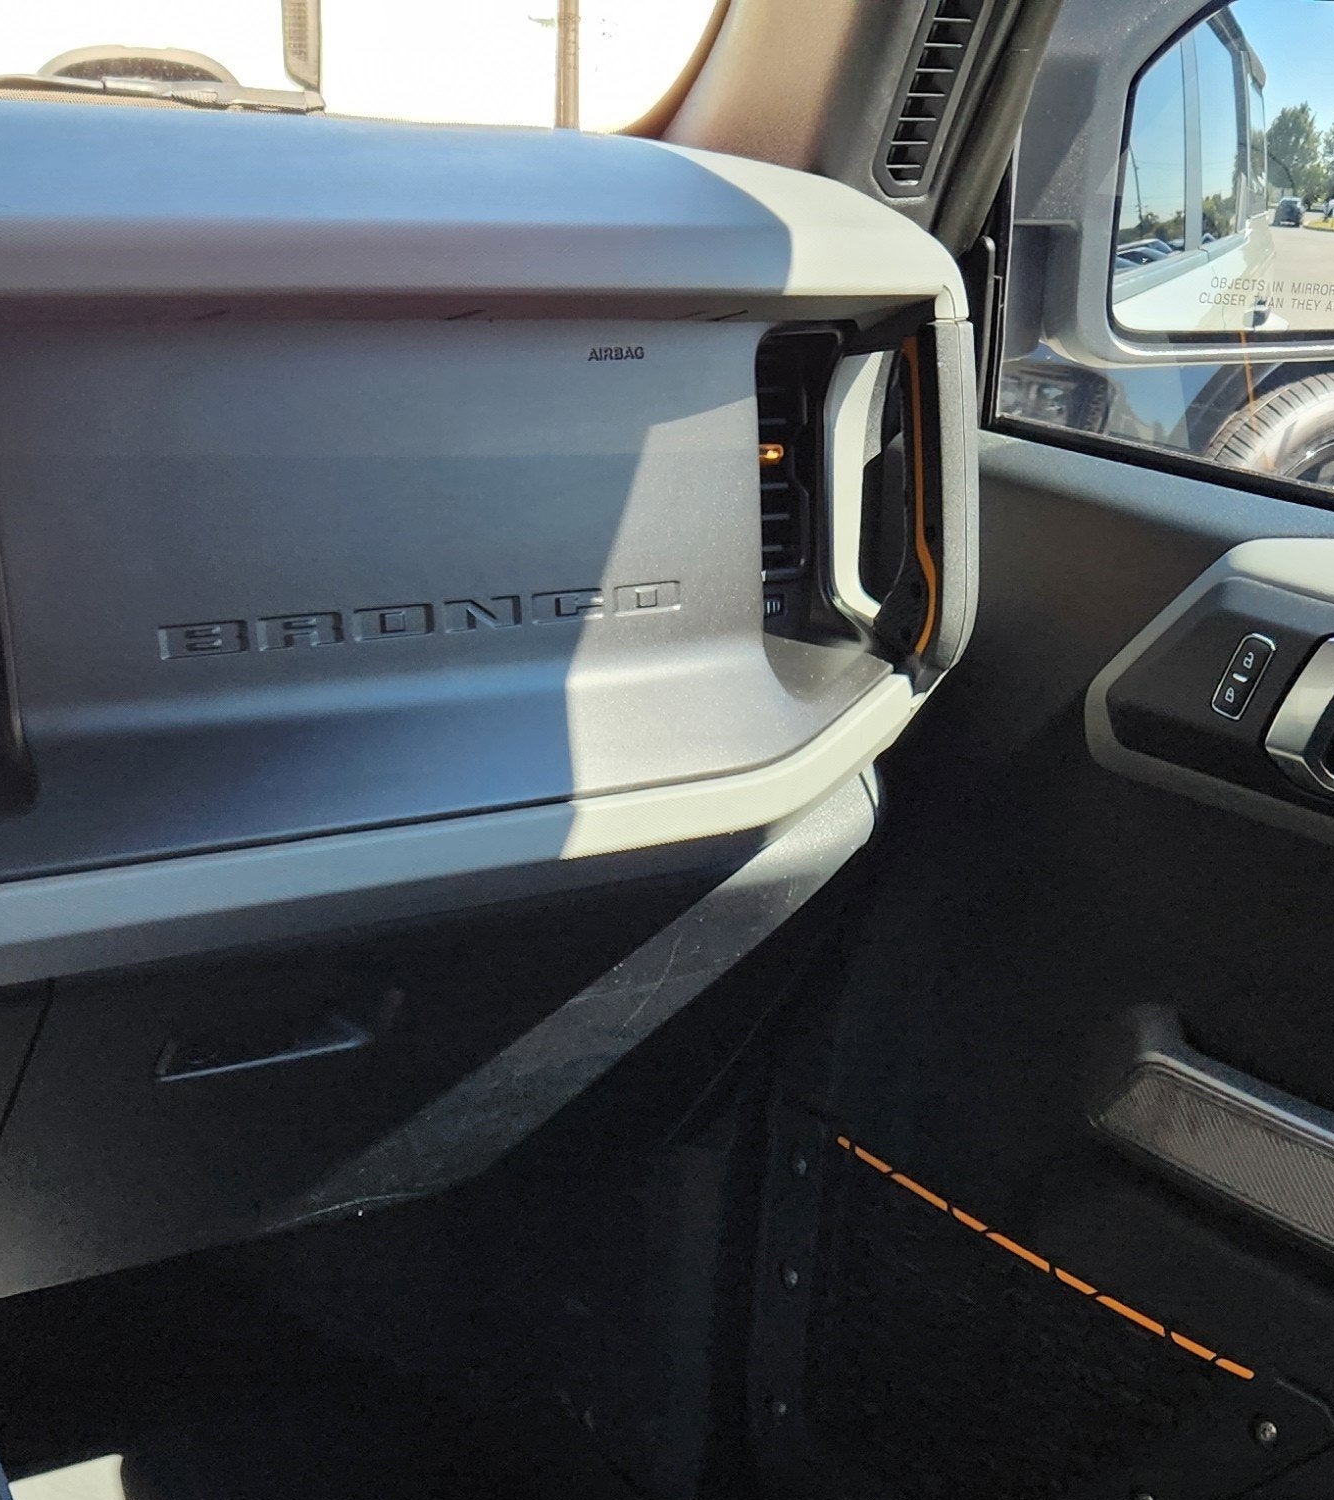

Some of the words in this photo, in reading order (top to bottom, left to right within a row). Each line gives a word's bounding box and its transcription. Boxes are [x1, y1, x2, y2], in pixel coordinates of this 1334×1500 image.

[1210, 276, 1265, 292] OBJECTS
[1272, 280, 1285, 293] IN
[1199, 292, 1247, 306] CLOSER
[1253, 294, 1284, 309] THAN
[1291, 297, 1322, 312] THEY
[587, 345, 645, 362] AIRBAG
[158, 579, 682, 661] BRONCO
